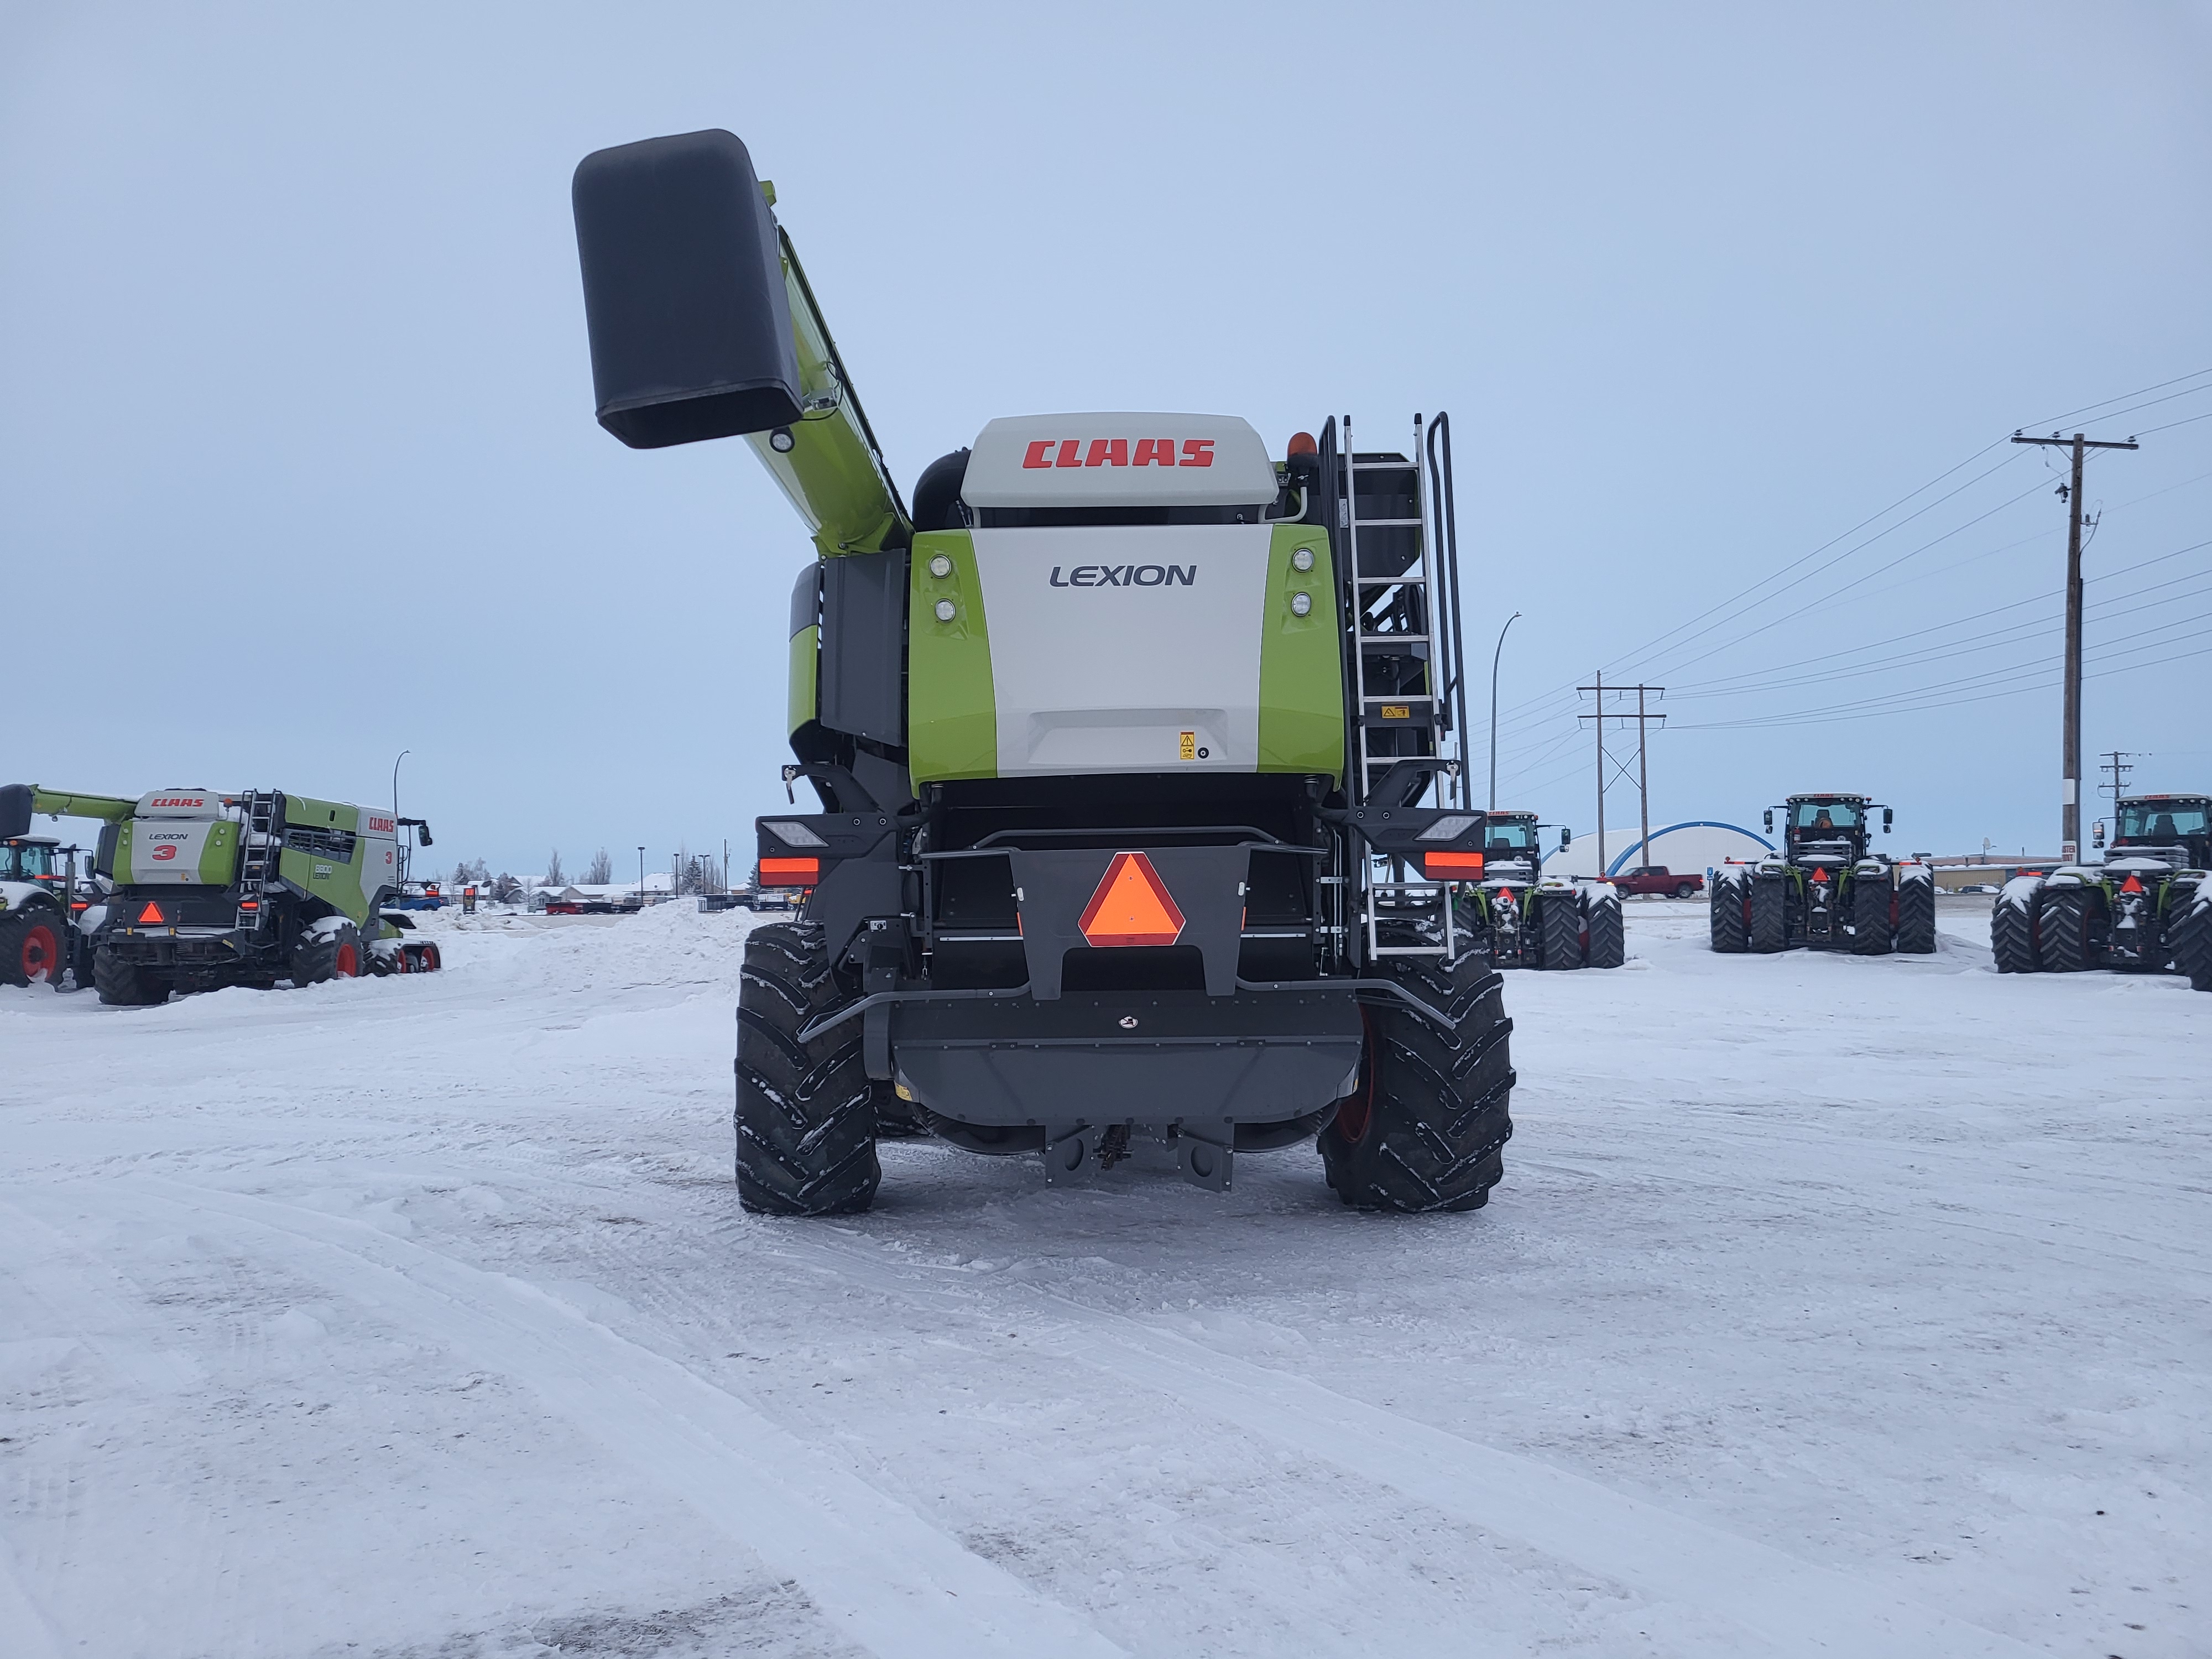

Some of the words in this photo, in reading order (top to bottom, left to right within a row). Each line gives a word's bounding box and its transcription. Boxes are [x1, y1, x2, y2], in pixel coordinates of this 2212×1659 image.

[1022, 439, 1215, 469] CLAAS
[1049, 565, 1197, 587] LEXION
[151, 799, 205, 807] CLAAS
[368, 817, 394, 833] CLAAS
[152, 844, 177, 861] 3
[385, 851, 392, 864] 3
